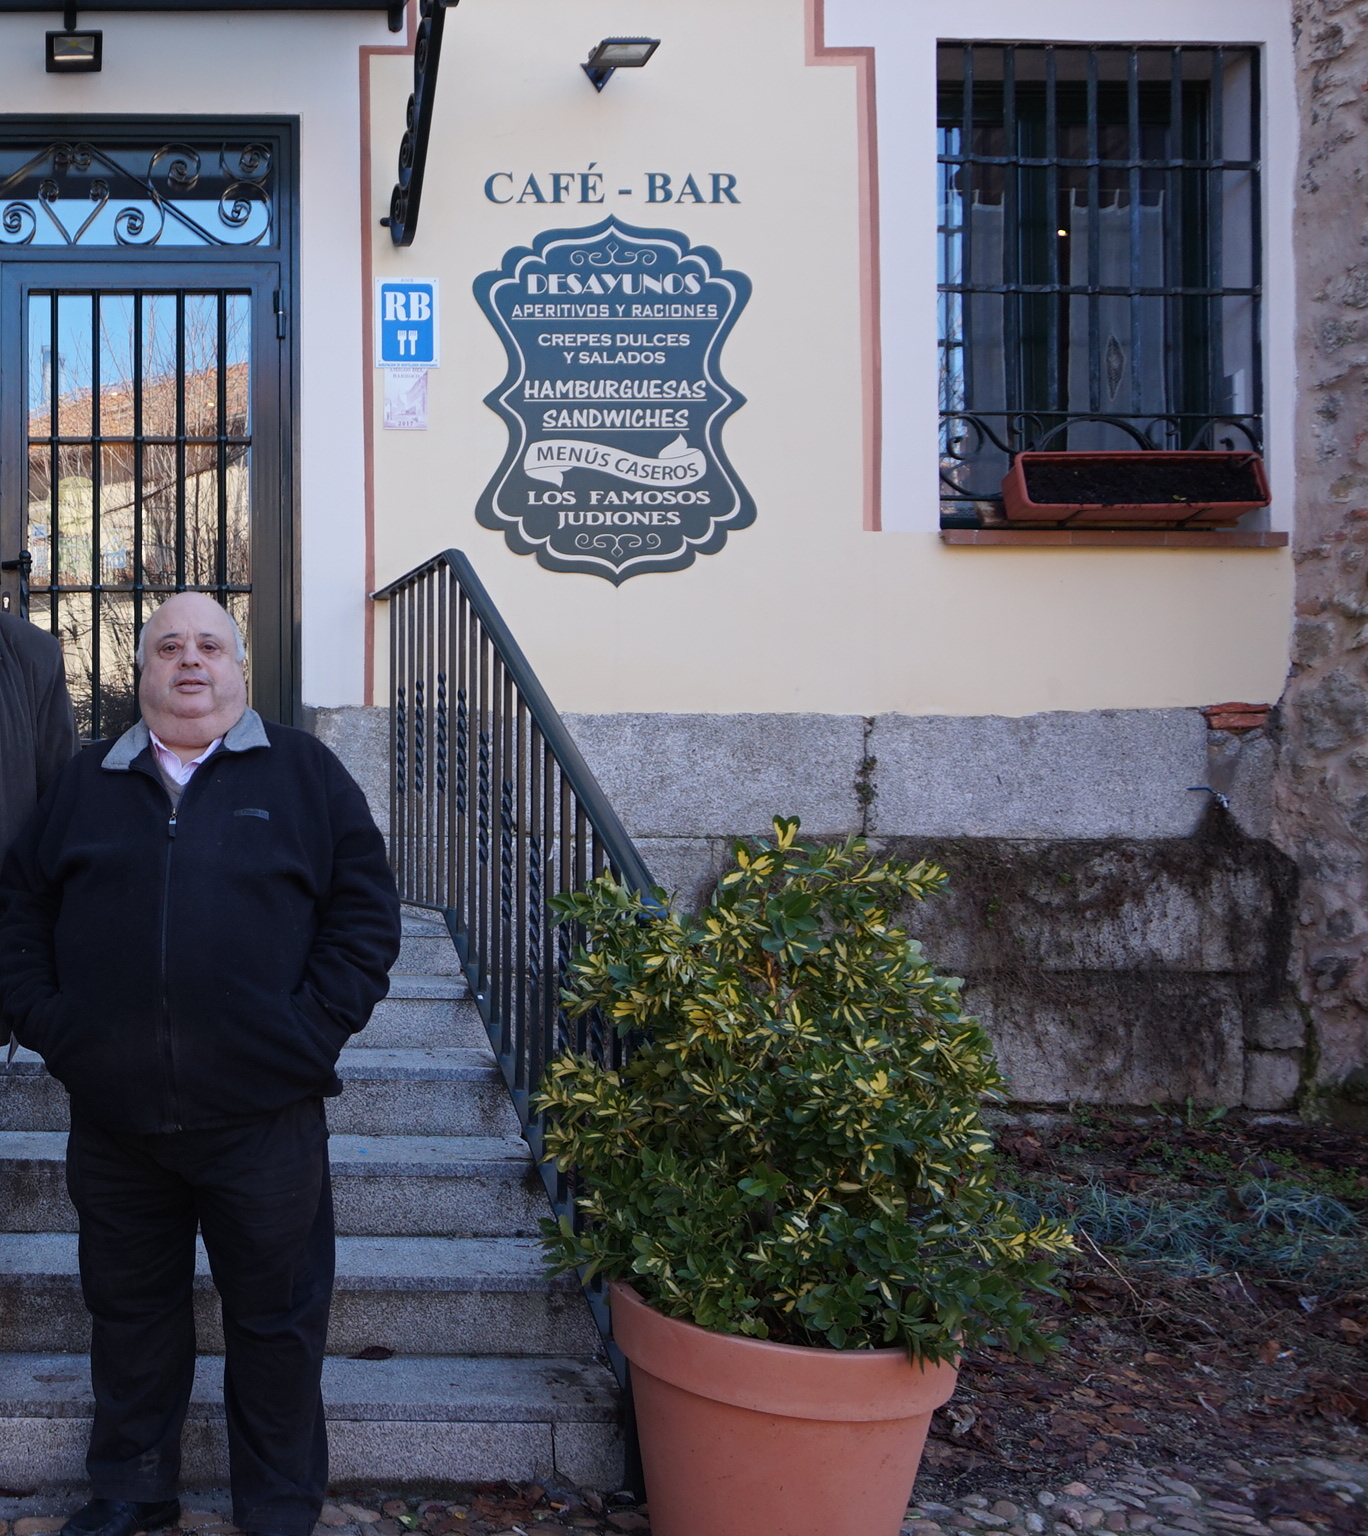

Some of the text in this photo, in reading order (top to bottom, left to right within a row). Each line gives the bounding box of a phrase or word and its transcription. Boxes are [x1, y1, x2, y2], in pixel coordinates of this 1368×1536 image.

[484, 162, 606, 204] CAFÉ
[644, 172, 742, 204] BAR
[527, 273, 702, 295] DESAYUNOS
[384, 291, 431, 321] RB
[512, 303, 719, 318] APERITIVOS Y RACIONES
[538, 333, 691, 347] CREPES DULCES
[563, 351, 667, 365] Y SALADOS
[523, 380, 707, 400] HAMBURGUESAS
[542, 409, 690, 429] SANDWICHES
[536, 445, 700, 481] MENÚS CASEROS
[527, 490, 712, 505] LOS FAMOSOS
[557, 511, 682, 530] JUDIONES
